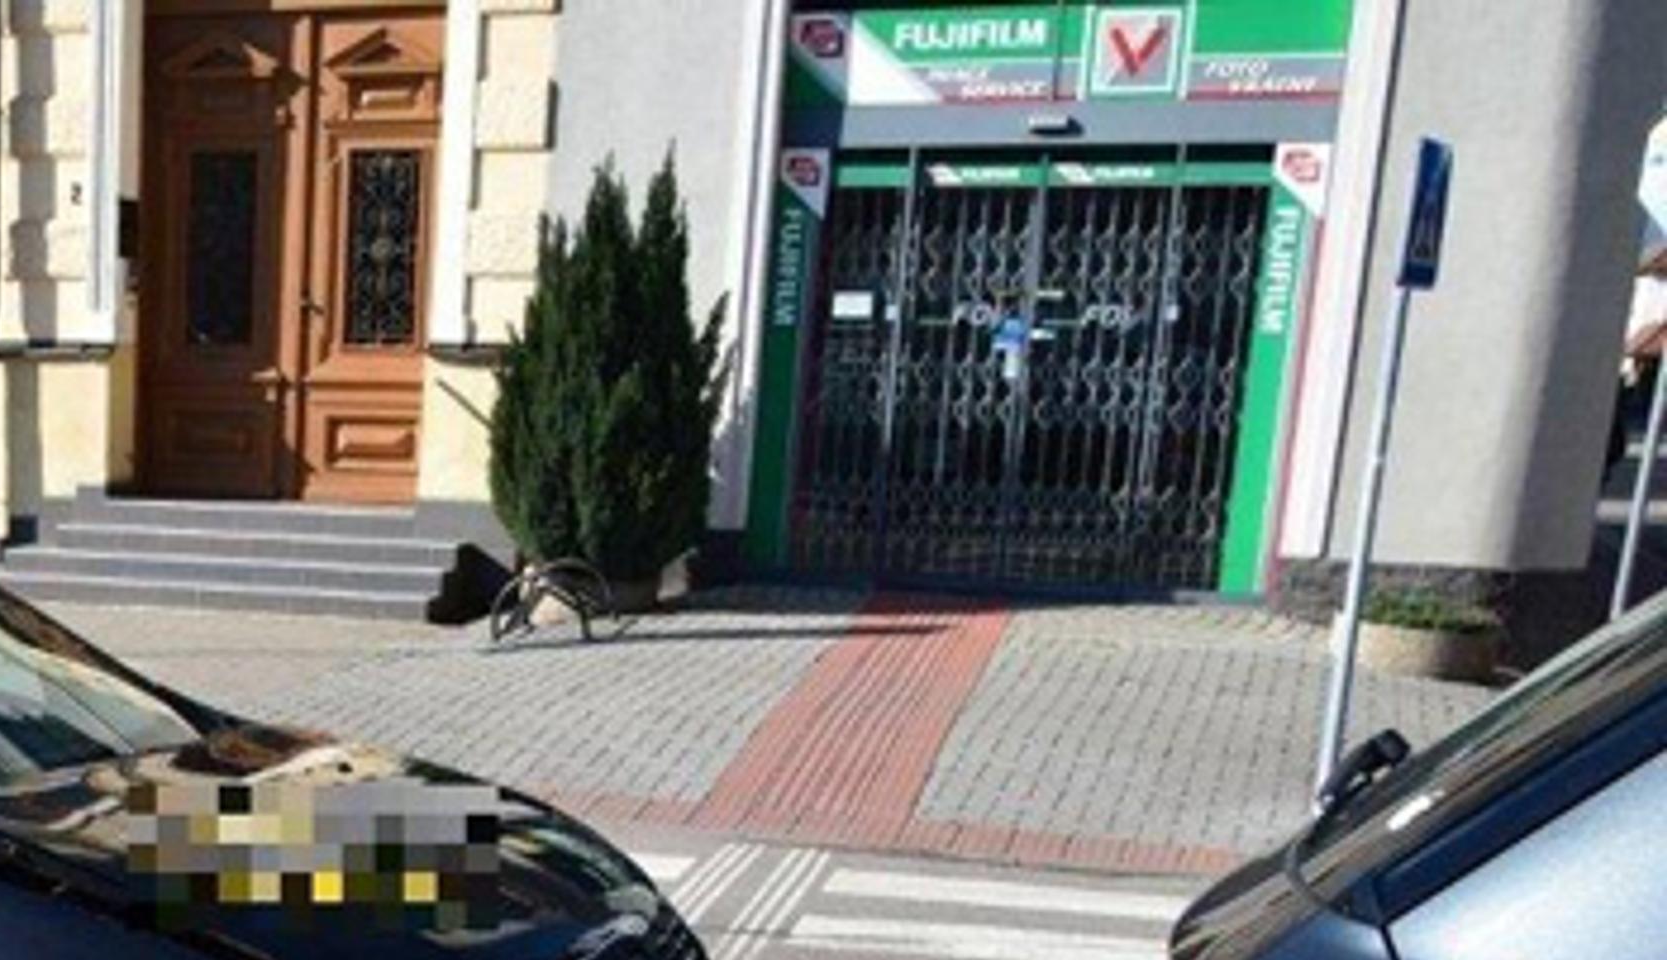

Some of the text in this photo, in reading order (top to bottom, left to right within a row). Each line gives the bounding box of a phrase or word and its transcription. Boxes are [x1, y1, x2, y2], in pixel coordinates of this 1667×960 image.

[894, 19, 1048, 49] FUJIFILM
[775, 208, 802, 326] FUJIFILM
[1259, 207, 1301, 335] FUJIFILM
